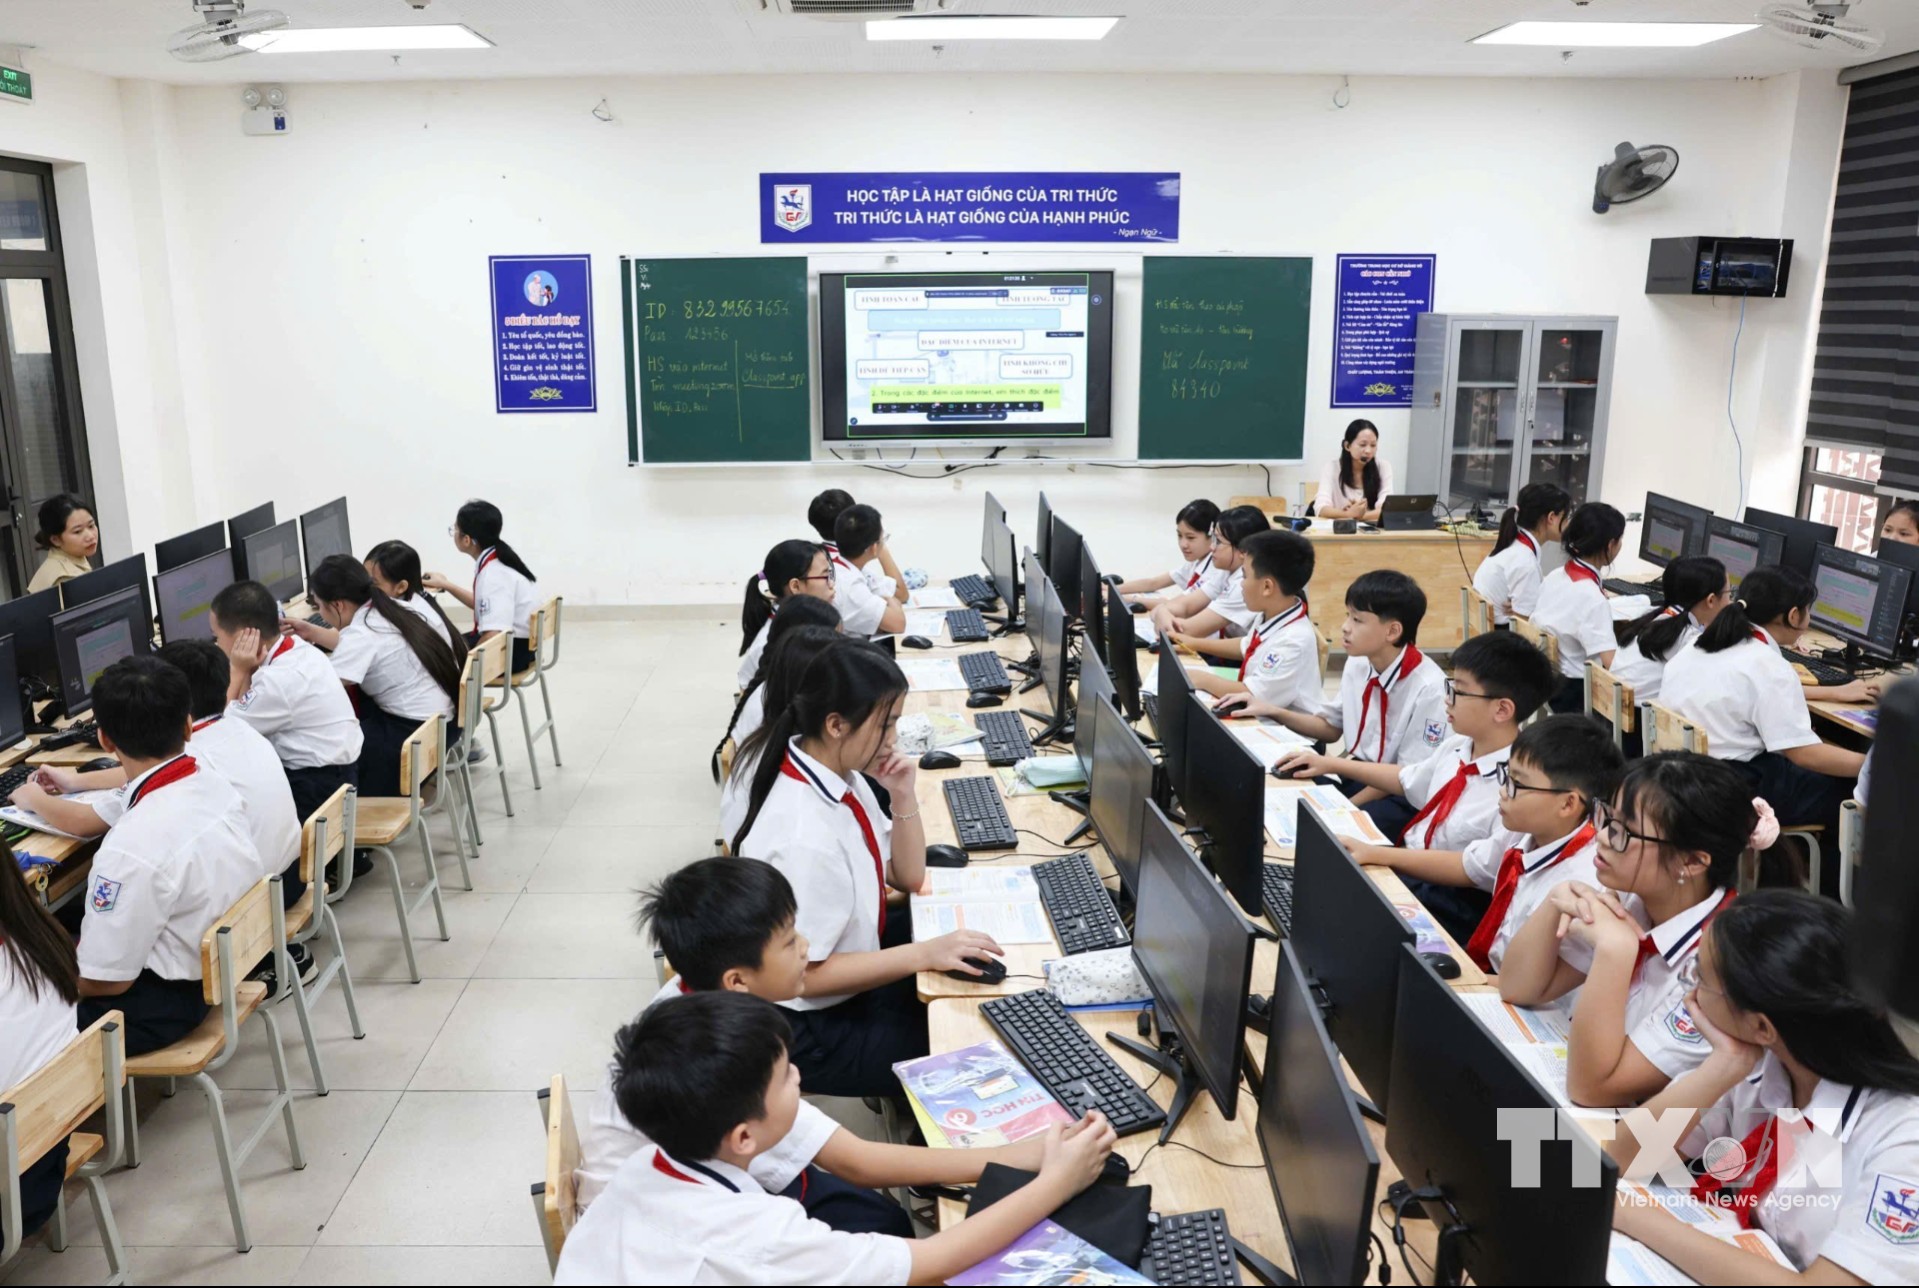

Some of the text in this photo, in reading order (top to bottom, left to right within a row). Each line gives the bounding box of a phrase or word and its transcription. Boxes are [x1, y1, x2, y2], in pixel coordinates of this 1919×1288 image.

[847, 186, 1118, 204] HỌC TẬP LÀ HẠT GIỐNG CỦA TRI THỨC
[834, 207, 1130, 227] TRI THỨC LÀ HẠT GIỐNG CỦA HẠNH PHÚC
[645, 302, 667, 319] ID
[648, 355, 665, 372] HS
[1171, 378, 1221, 400] 84340
